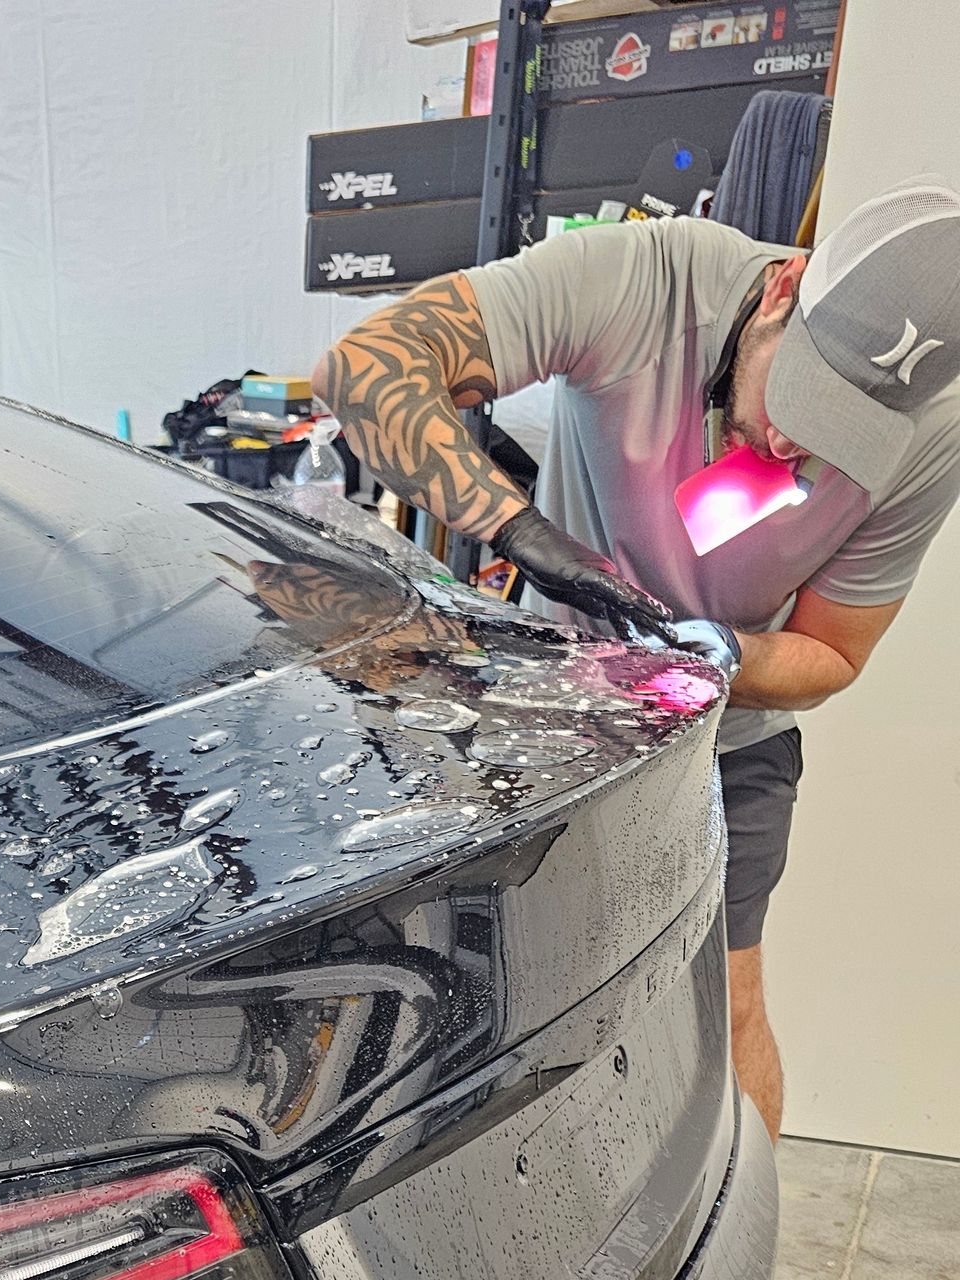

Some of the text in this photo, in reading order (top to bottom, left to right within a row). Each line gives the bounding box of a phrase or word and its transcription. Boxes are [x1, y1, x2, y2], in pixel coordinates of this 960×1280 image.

[560, 54, 601, 73] THAN
[753, 53, 811, 75] SHIELD
[324, 170, 397, 201] XPEL
[322, 251, 396, 281] XPEL
